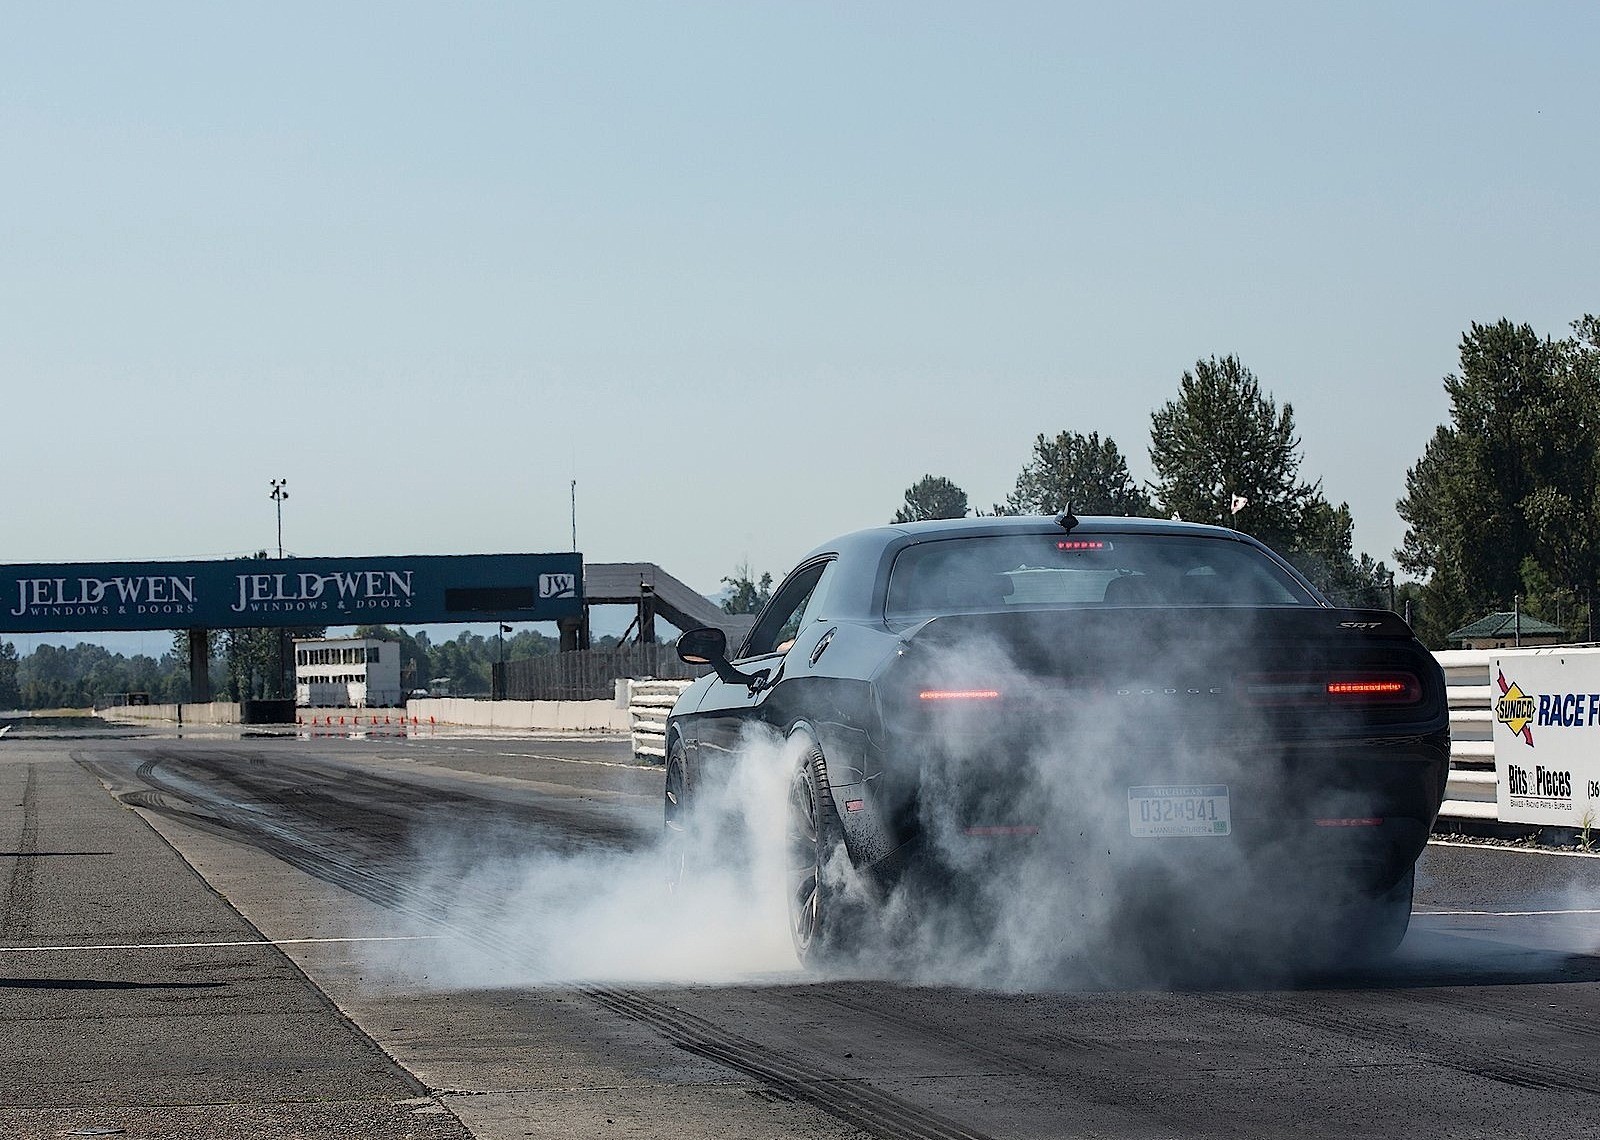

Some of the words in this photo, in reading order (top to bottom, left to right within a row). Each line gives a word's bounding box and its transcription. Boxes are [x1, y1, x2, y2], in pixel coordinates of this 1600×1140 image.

[543, 576, 573, 595] JW
[30, 606, 109, 616] WINDOWS
[118, 606, 127, 614] &
[138, 604, 194, 614] DOORS
[251, 601, 328, 612] WINDOWS
[338, 600, 345, 609] &
[356, 599, 412, 609] DOORS
[1117, 688, 1224, 696] DODGE
[1500, 700, 1532, 719] SUNOCO
[1538, 694, 1586, 727] RACE
[1588, 694, 1600, 727] F
[1509, 765, 1528, 795] Bits
[1536, 765, 1571, 797] Pieces
[1153, 787, 1204, 796] MICHIGAN
[1153, 825, 1208, 834] MANUFACTURER
